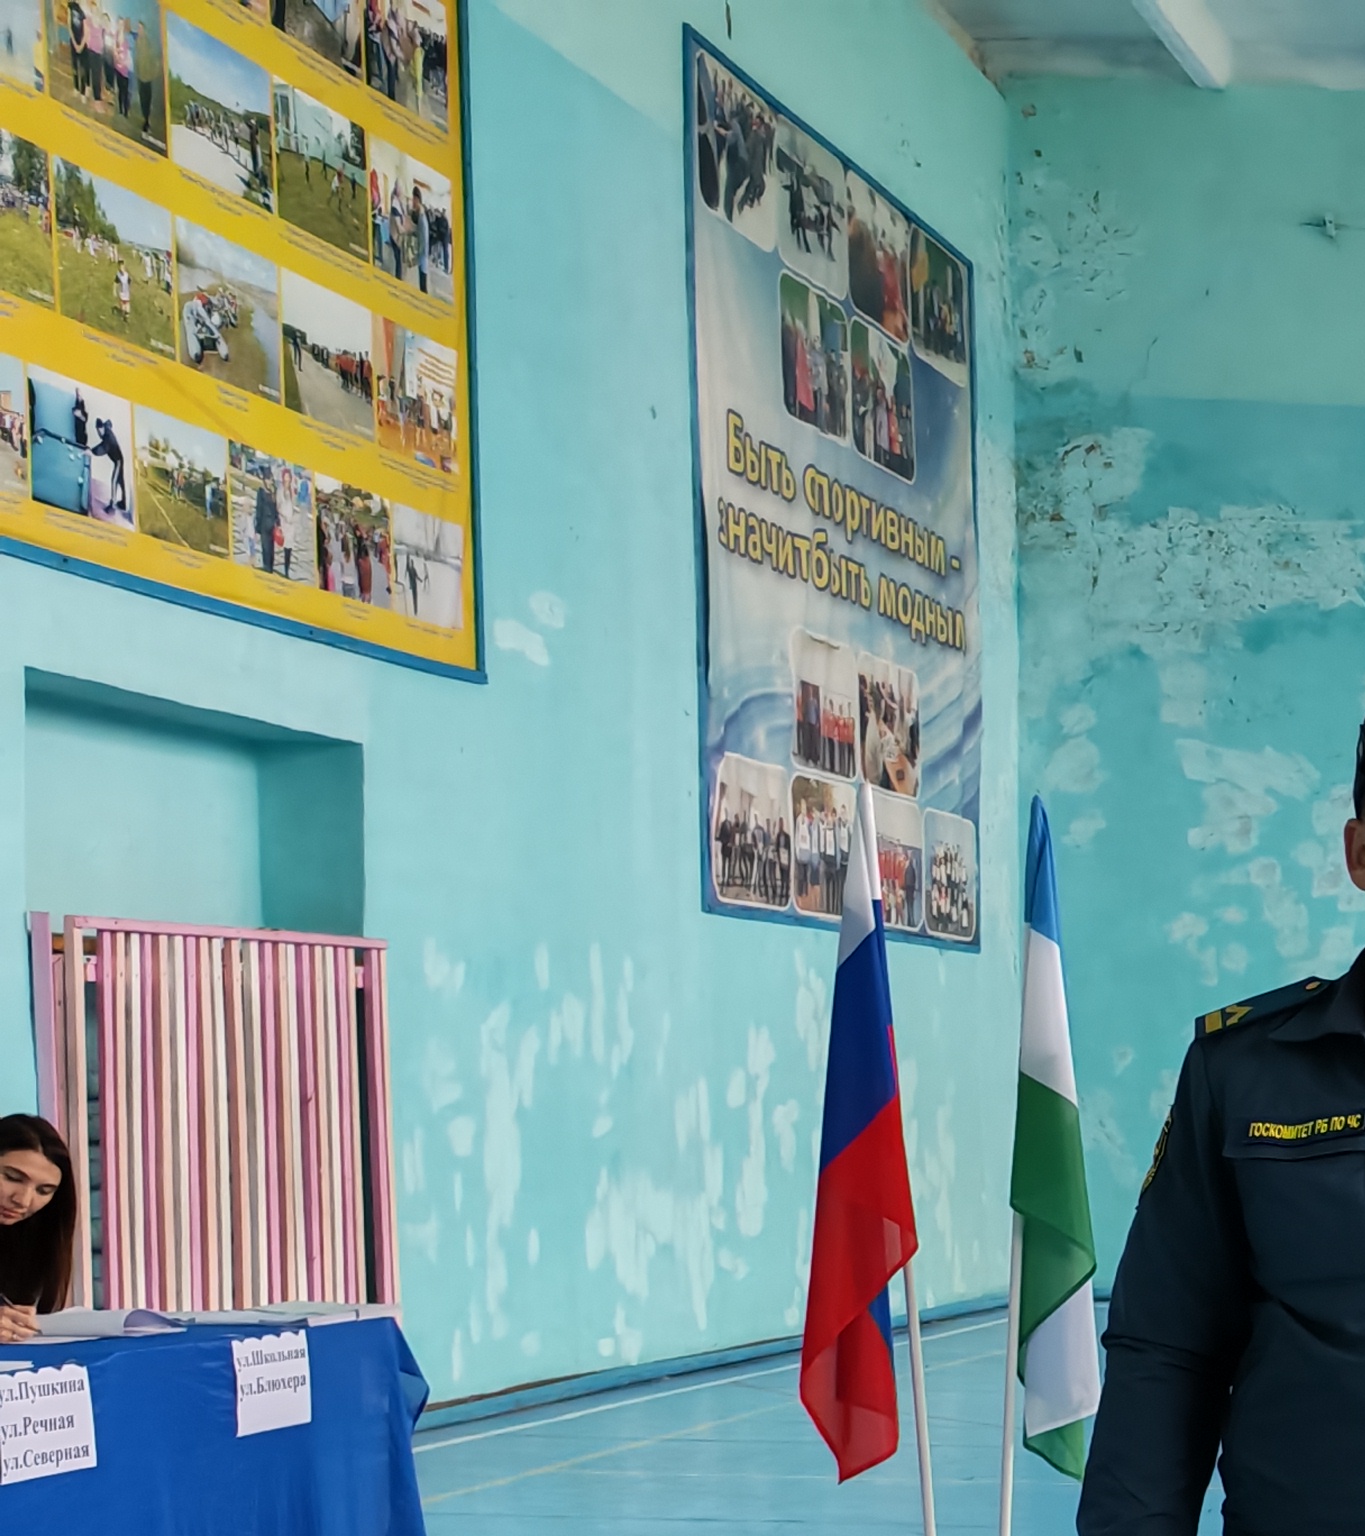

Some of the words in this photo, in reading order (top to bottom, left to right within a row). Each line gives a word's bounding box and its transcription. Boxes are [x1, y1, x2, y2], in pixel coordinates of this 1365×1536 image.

[727, 409, 796, 502] Быть
[1248, 1120, 1315, 1140] ГОСКОМИТЕТ
[1314, 1118, 1329, 1135] РБ
[1329, 1115, 1346, 1132] ПО
[1346, 1113, 1362, 1128] ЧС
[240, 1374, 306, 1402] ул.Блюхера
[1, 1414, 75, 1446] ул.Речная
[3, 1444, 90, 1477] ул.Северная
